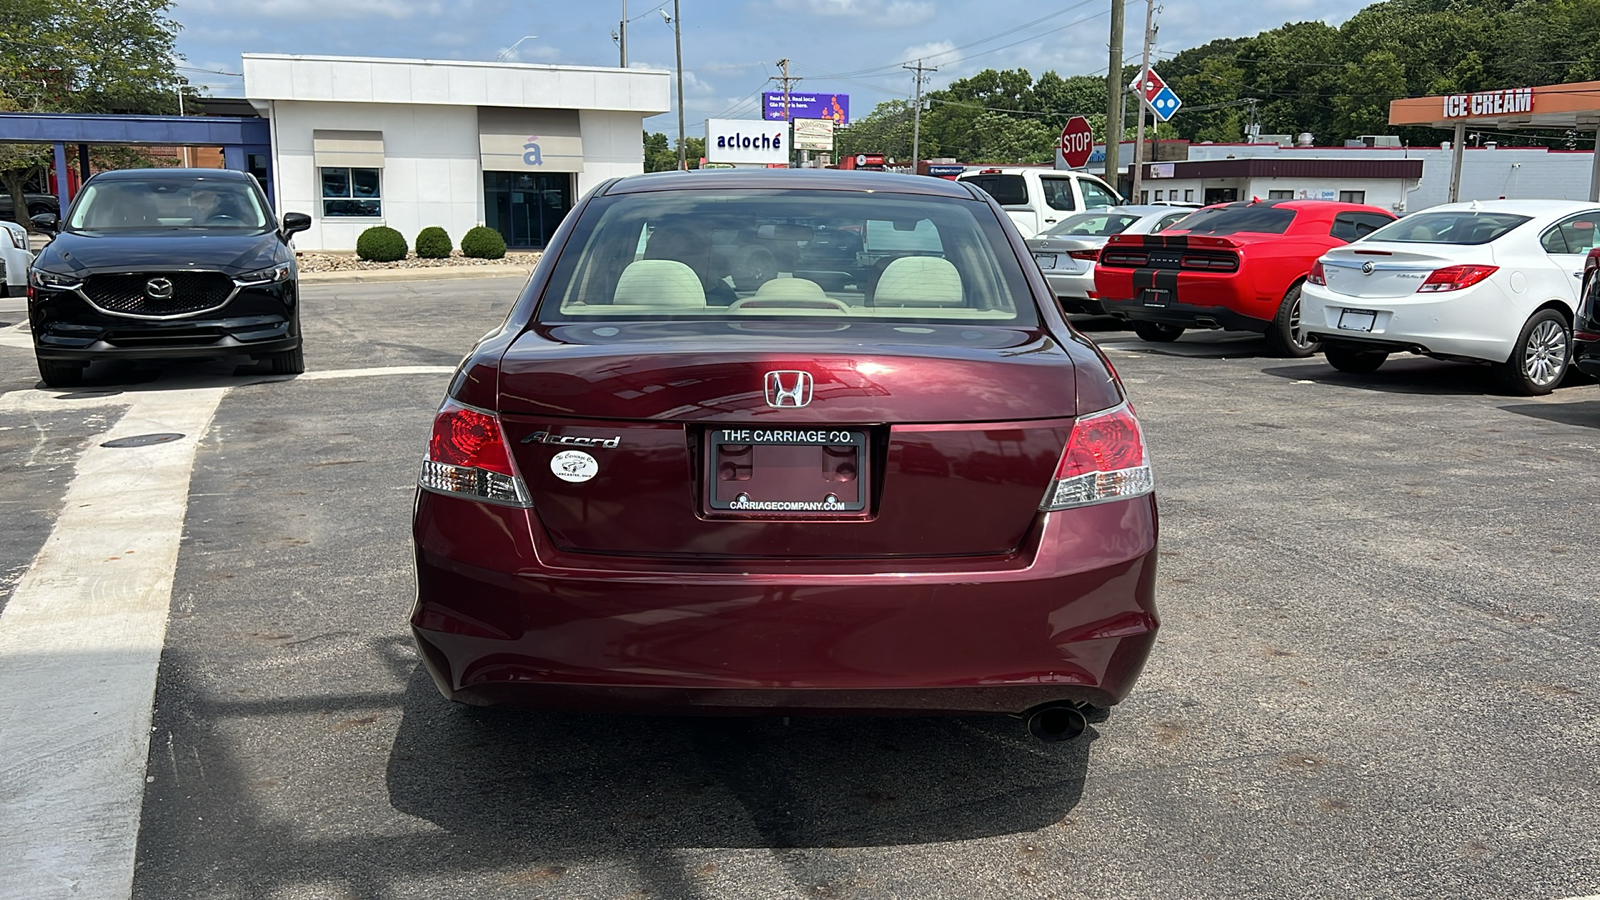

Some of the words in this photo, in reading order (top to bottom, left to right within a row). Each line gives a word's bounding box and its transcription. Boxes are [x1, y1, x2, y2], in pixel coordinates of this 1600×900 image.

[1443, 95, 1468, 118] ICE
[1471, 88, 1532, 115] CREAM
[717, 132, 781, 149] acloché
[1063, 131, 1091, 154] STOP
[523, 135, 543, 166] á
[521, 431, 621, 449] Accord
[722, 430, 750, 442] THE
[753, 430, 827, 442] CARRIAGE
[830, 431, 854, 443] CO.
[729, 501, 845, 510] CARRIAGECOMPANY.COM
